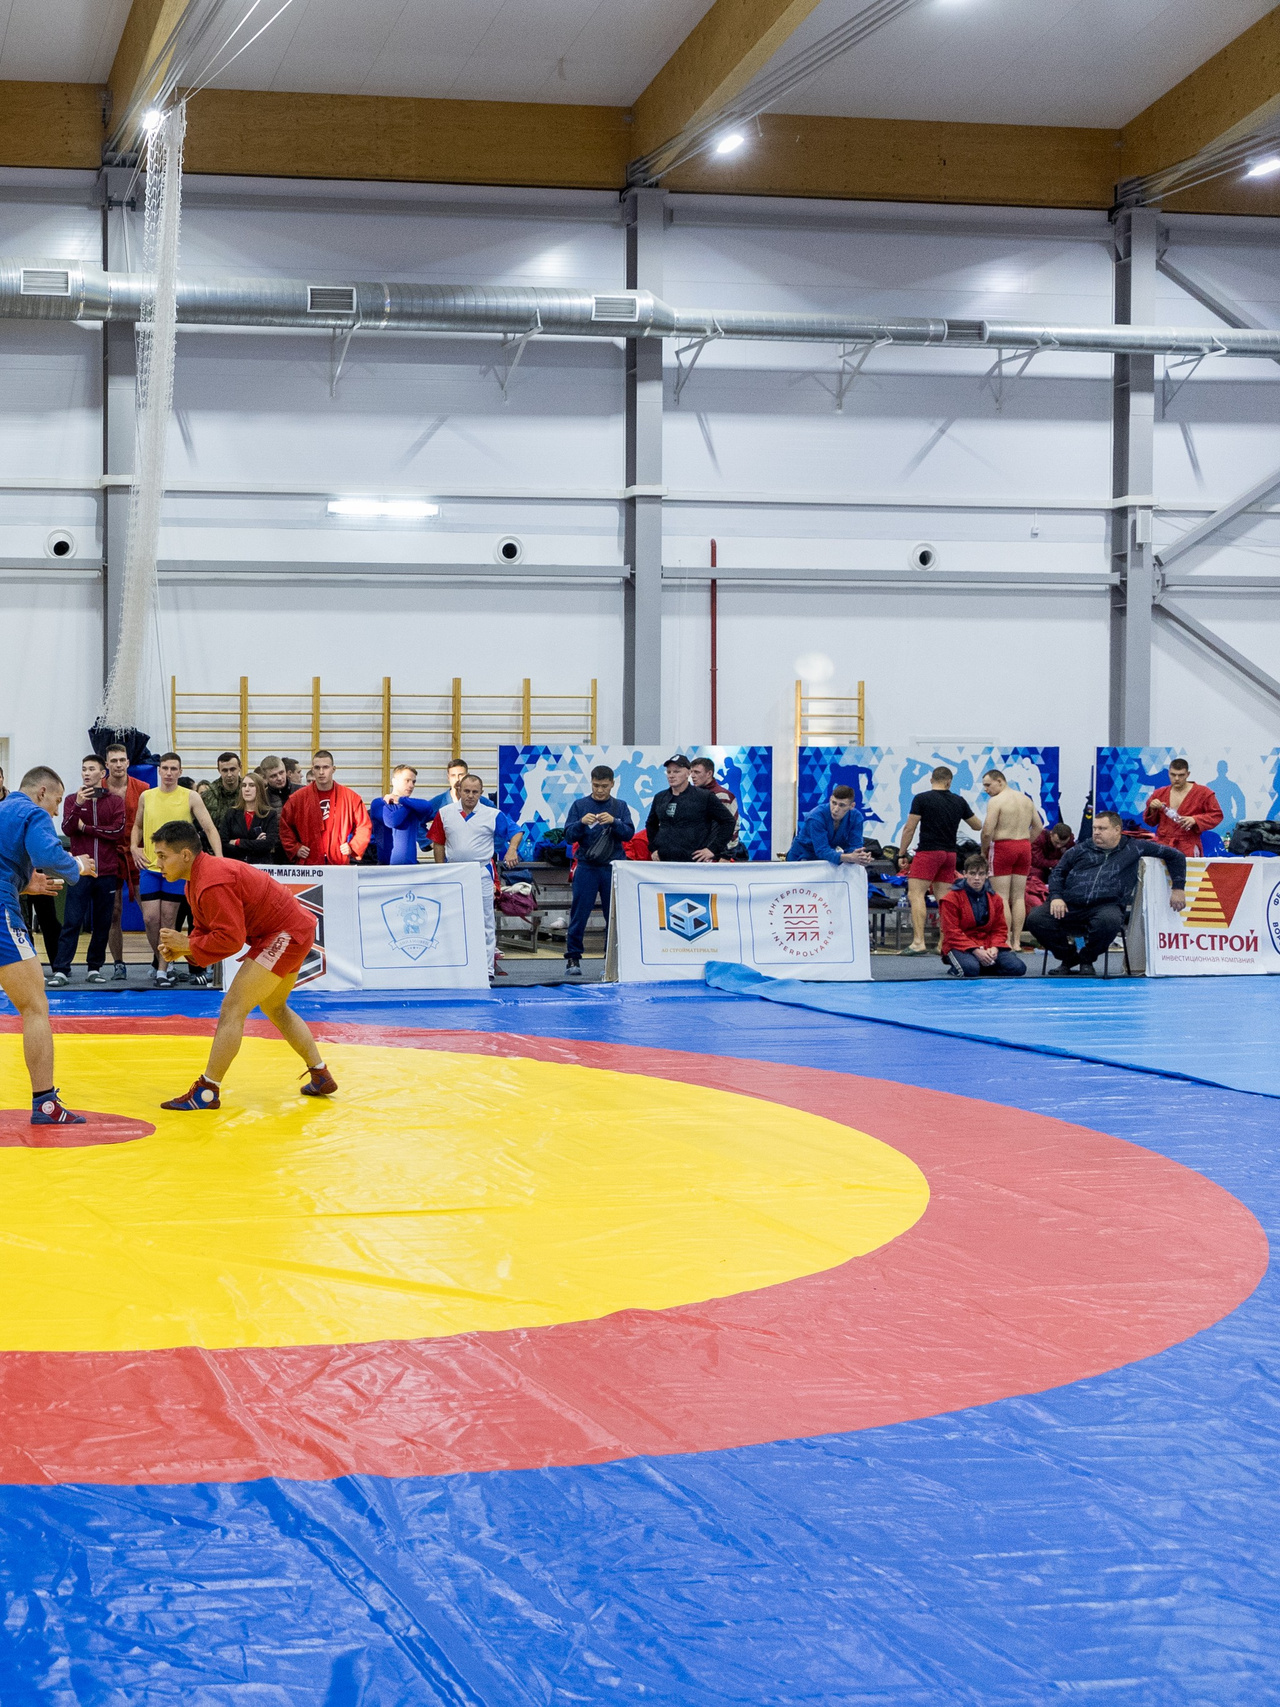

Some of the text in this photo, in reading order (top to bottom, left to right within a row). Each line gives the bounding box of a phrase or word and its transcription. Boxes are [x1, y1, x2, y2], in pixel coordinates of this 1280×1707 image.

[768, 888, 832, 916] ИНТЕРПОЛЯРИС
[771, 930, 834, 957] INTERPOLYARIS
[1161, 955, 1221, 963] инвестиционная
